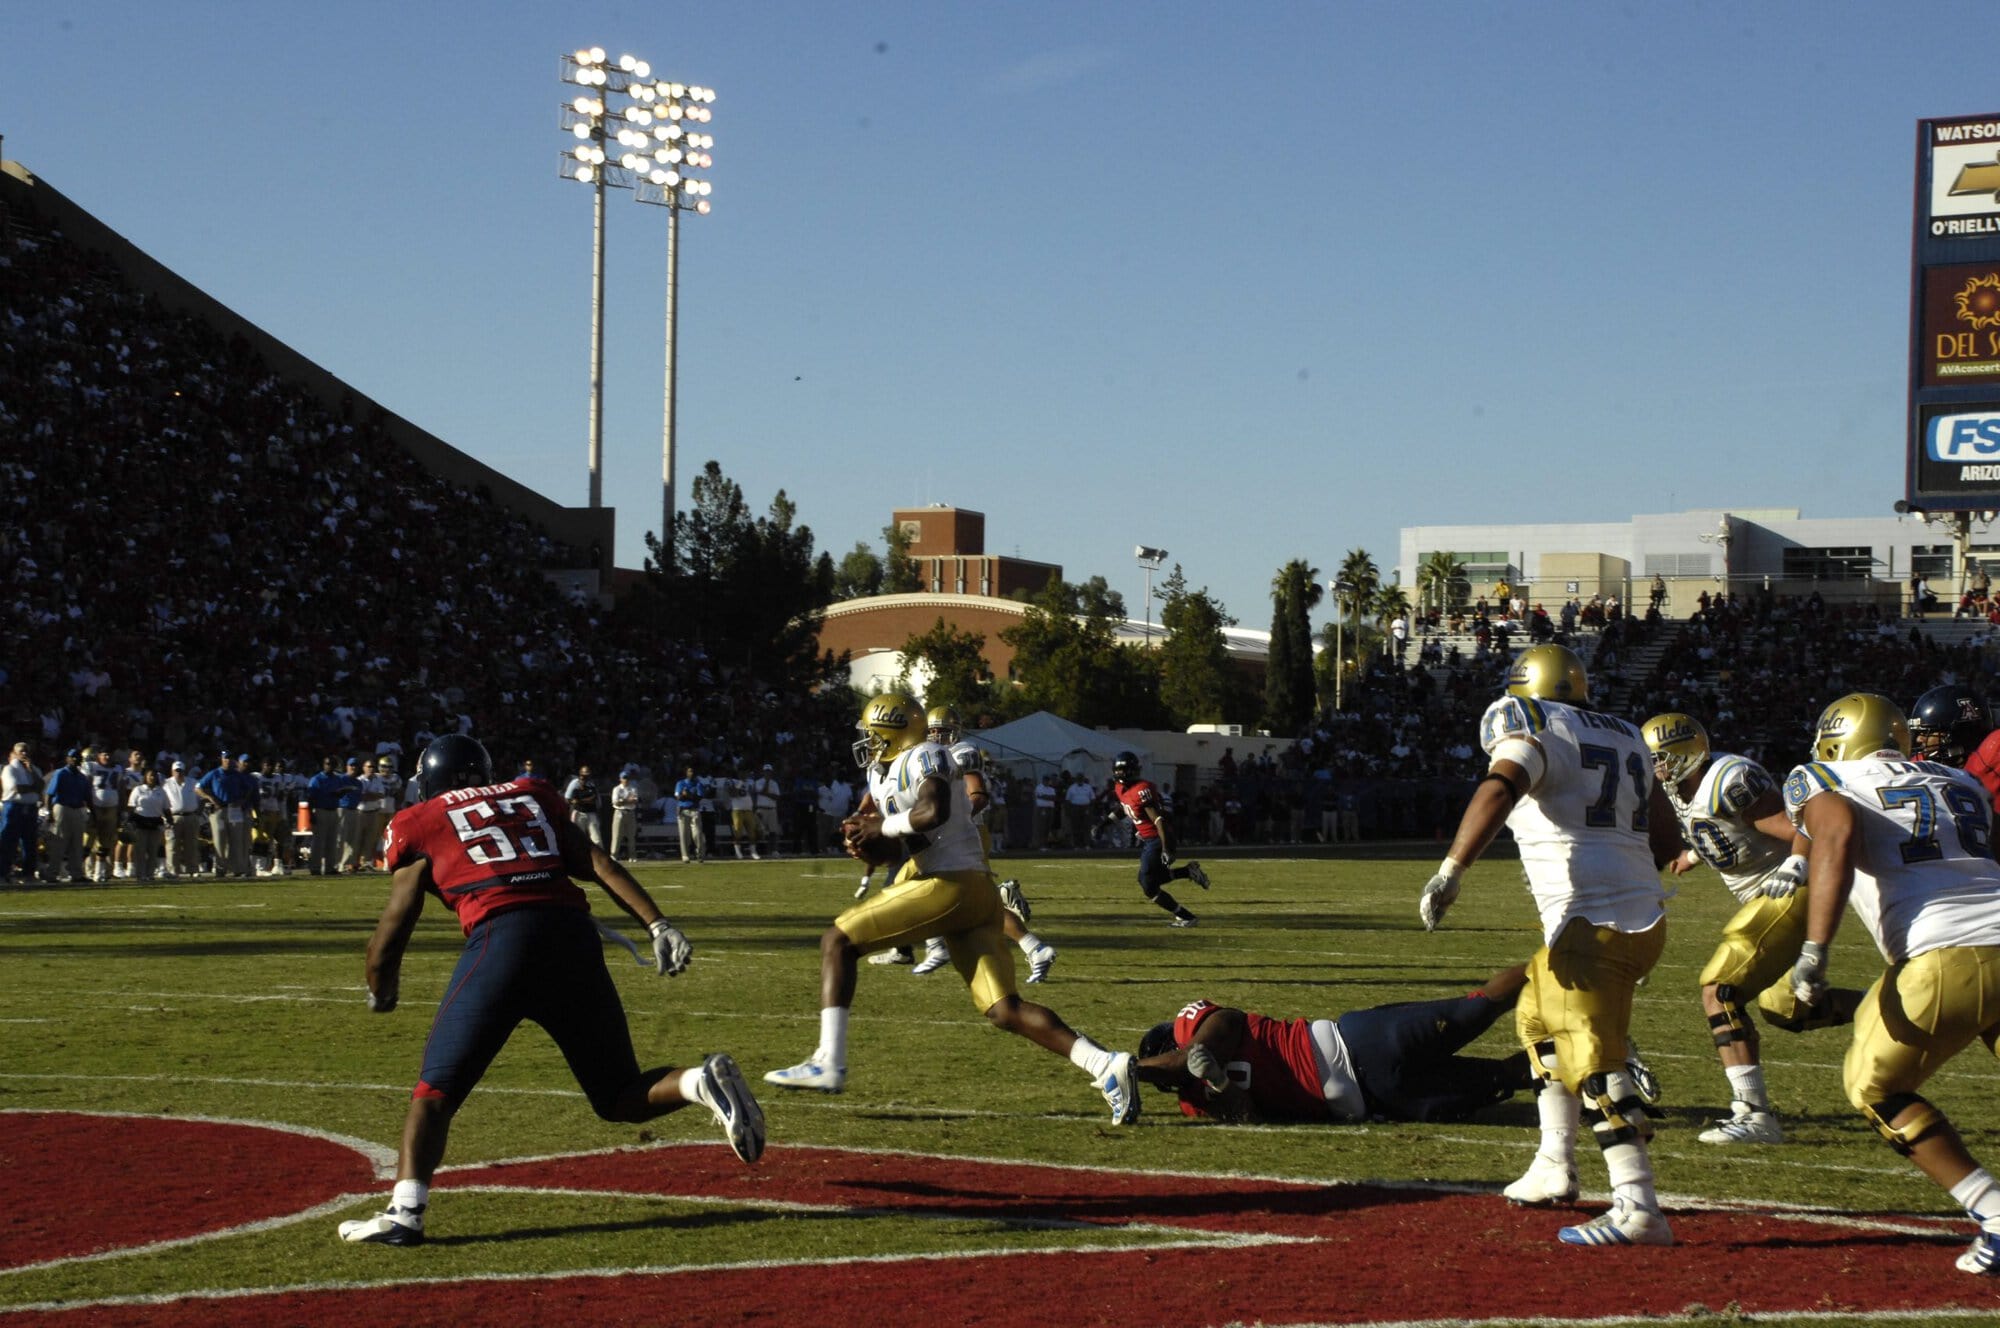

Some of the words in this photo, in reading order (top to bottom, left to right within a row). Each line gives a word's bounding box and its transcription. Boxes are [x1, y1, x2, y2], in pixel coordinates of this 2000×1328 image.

[1937, 123, 2000, 141] WATSO
[1937, 333, 1979, 359] DEL
[1989, 331, 2000, 356] S
[1960, 465, 2000, 481] ARIZO
[873, 704, 908, 729] Ucla
[1652, 720, 1697, 748] Ucla
[1579, 743, 1650, 831] 71
[1783, 769, 1811, 806] 8
[447, 795, 560, 865] 53
[1875, 782, 1992, 863] 78
[1690, 817, 1738, 869] 0
[511, 871, 551, 883] ARIZONA
